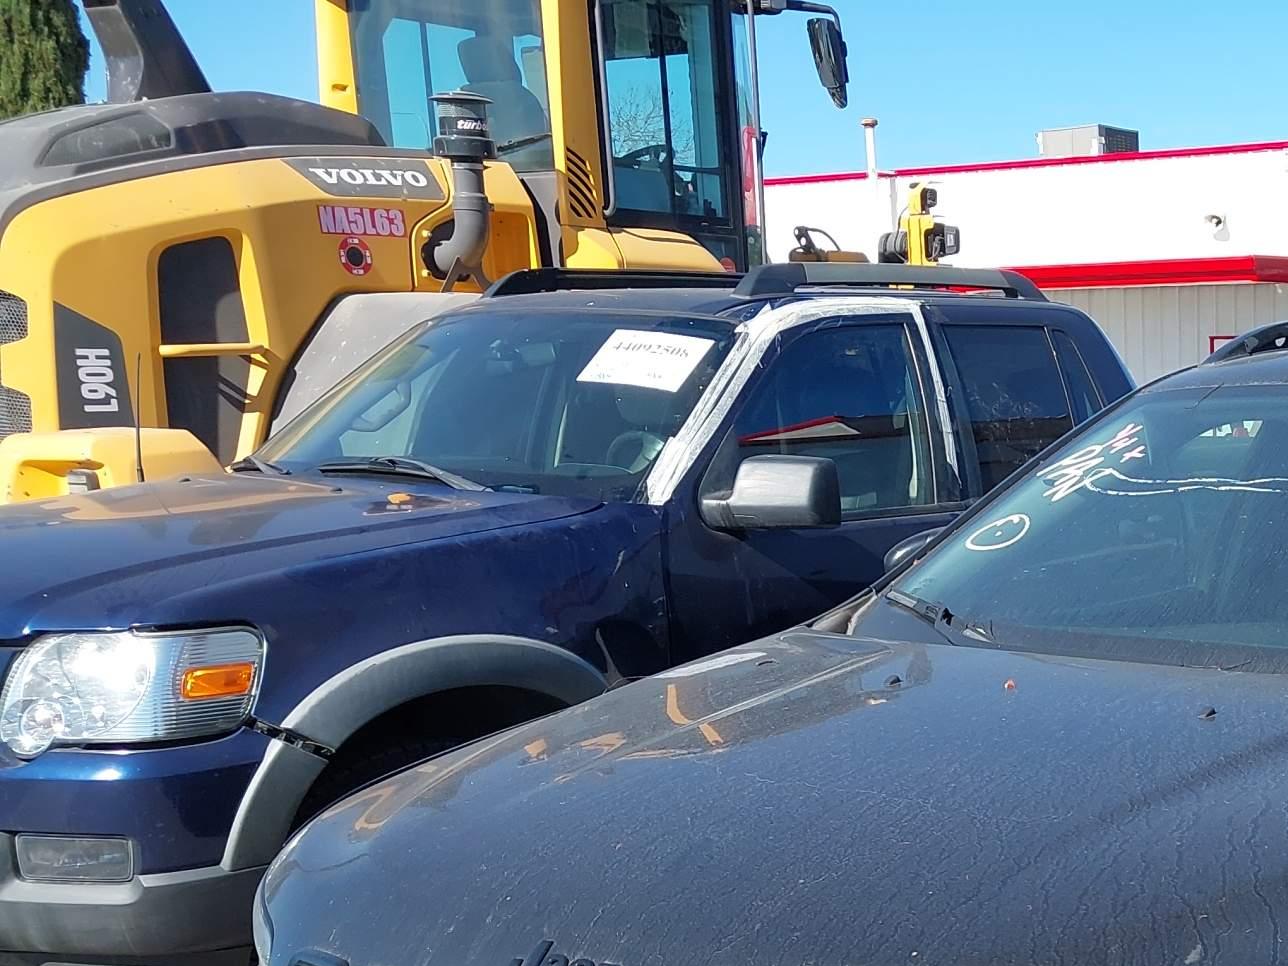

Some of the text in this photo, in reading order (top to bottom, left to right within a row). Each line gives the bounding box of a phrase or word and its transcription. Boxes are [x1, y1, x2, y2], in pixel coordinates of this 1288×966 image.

[308, 167, 428, 187] VOLVO
[319, 205, 405, 237] NA5L63
[74, 348, 119, 412] L90H
